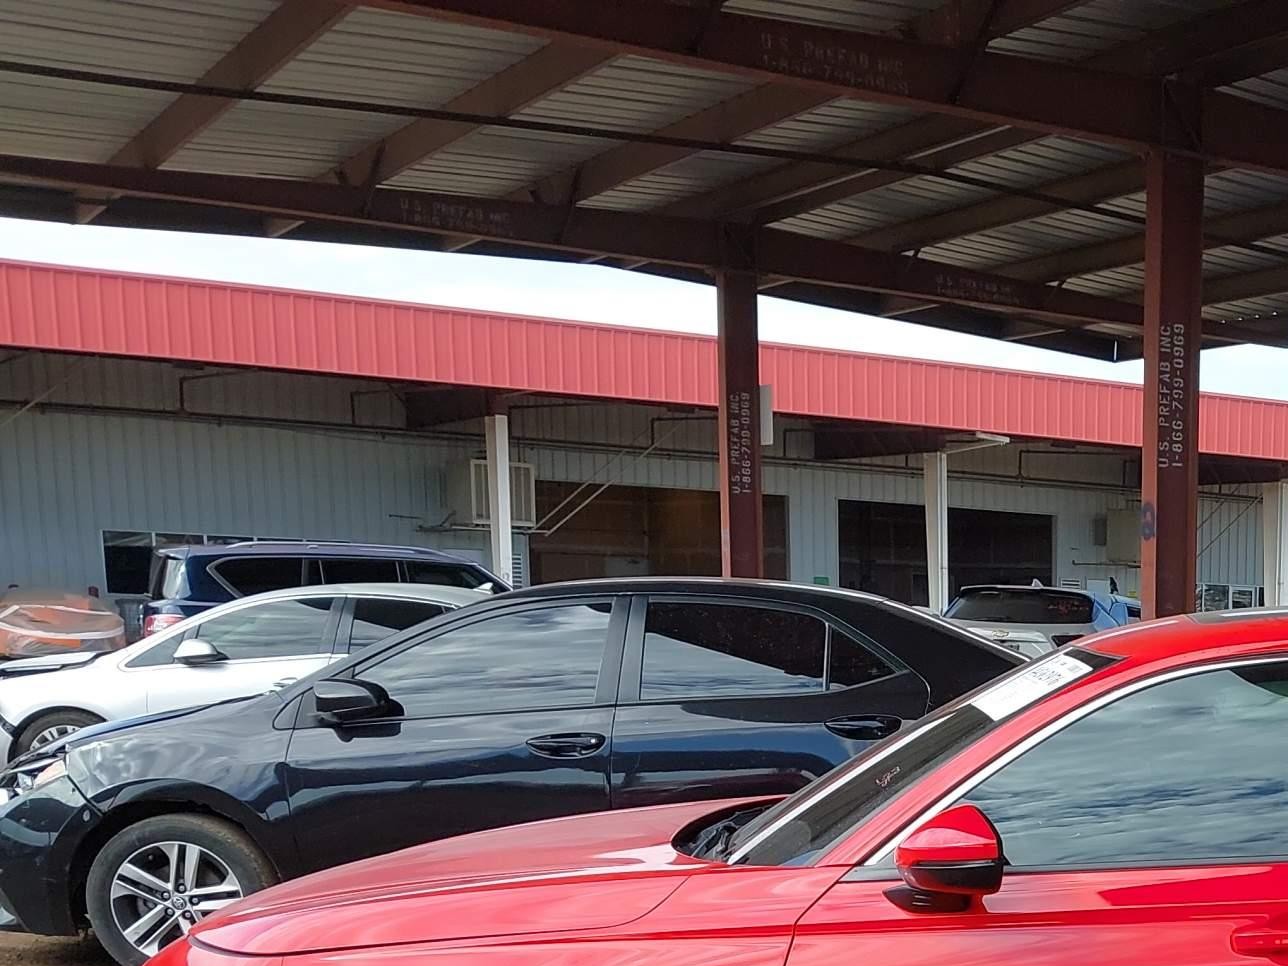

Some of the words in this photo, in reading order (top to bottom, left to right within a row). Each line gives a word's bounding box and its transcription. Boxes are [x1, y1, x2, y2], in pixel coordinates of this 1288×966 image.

[1158, 361, 1171, 427] PREFAB
[1171, 323, 1184, 468] 1-866-799-0969
[731, 419, 740, 465] PREFAB
[741, 392, 751, 494] 1-866-799-0969
[1158, 437, 1170, 468] U.S.
[731, 471, 740, 494] U.S.
